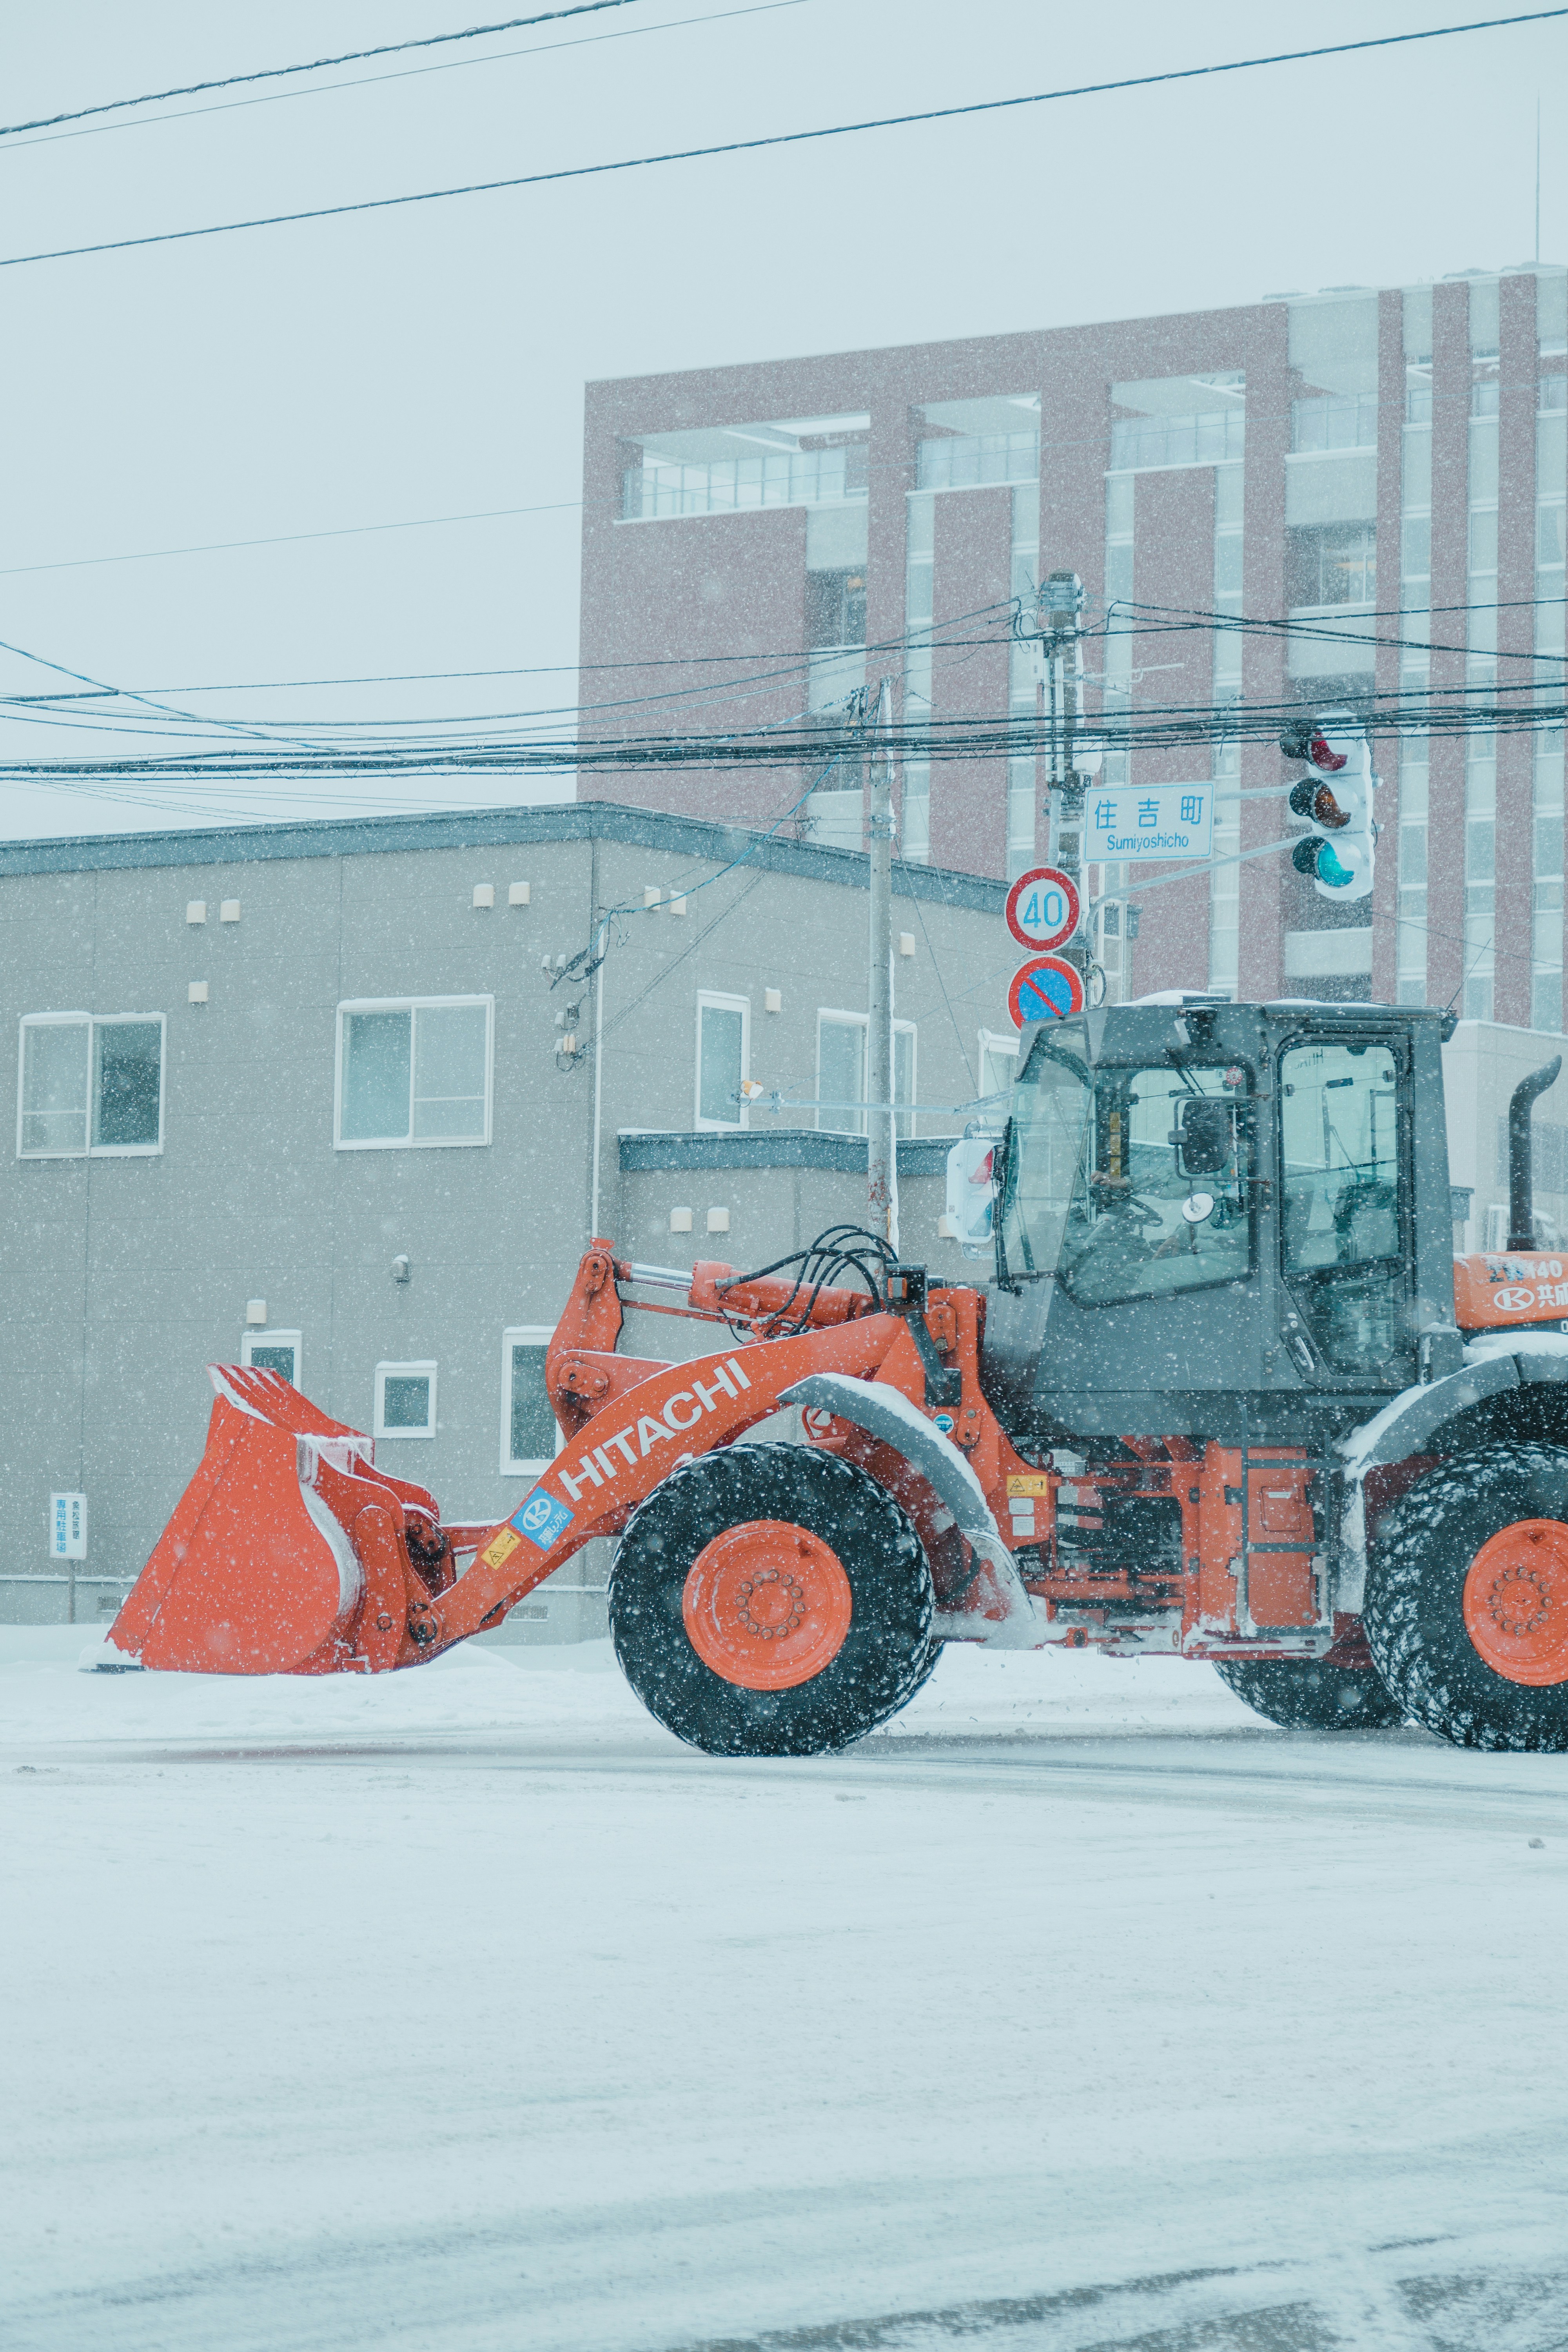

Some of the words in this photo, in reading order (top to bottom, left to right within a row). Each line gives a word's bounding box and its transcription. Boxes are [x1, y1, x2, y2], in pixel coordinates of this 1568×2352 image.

[1095, 795, 1204, 829] 住吉町
[1107, 832, 1189, 853] Sumiyoshicho
[1024, 891, 1063, 928] 40
[558, 1357, 752, 1502] HITACHI
